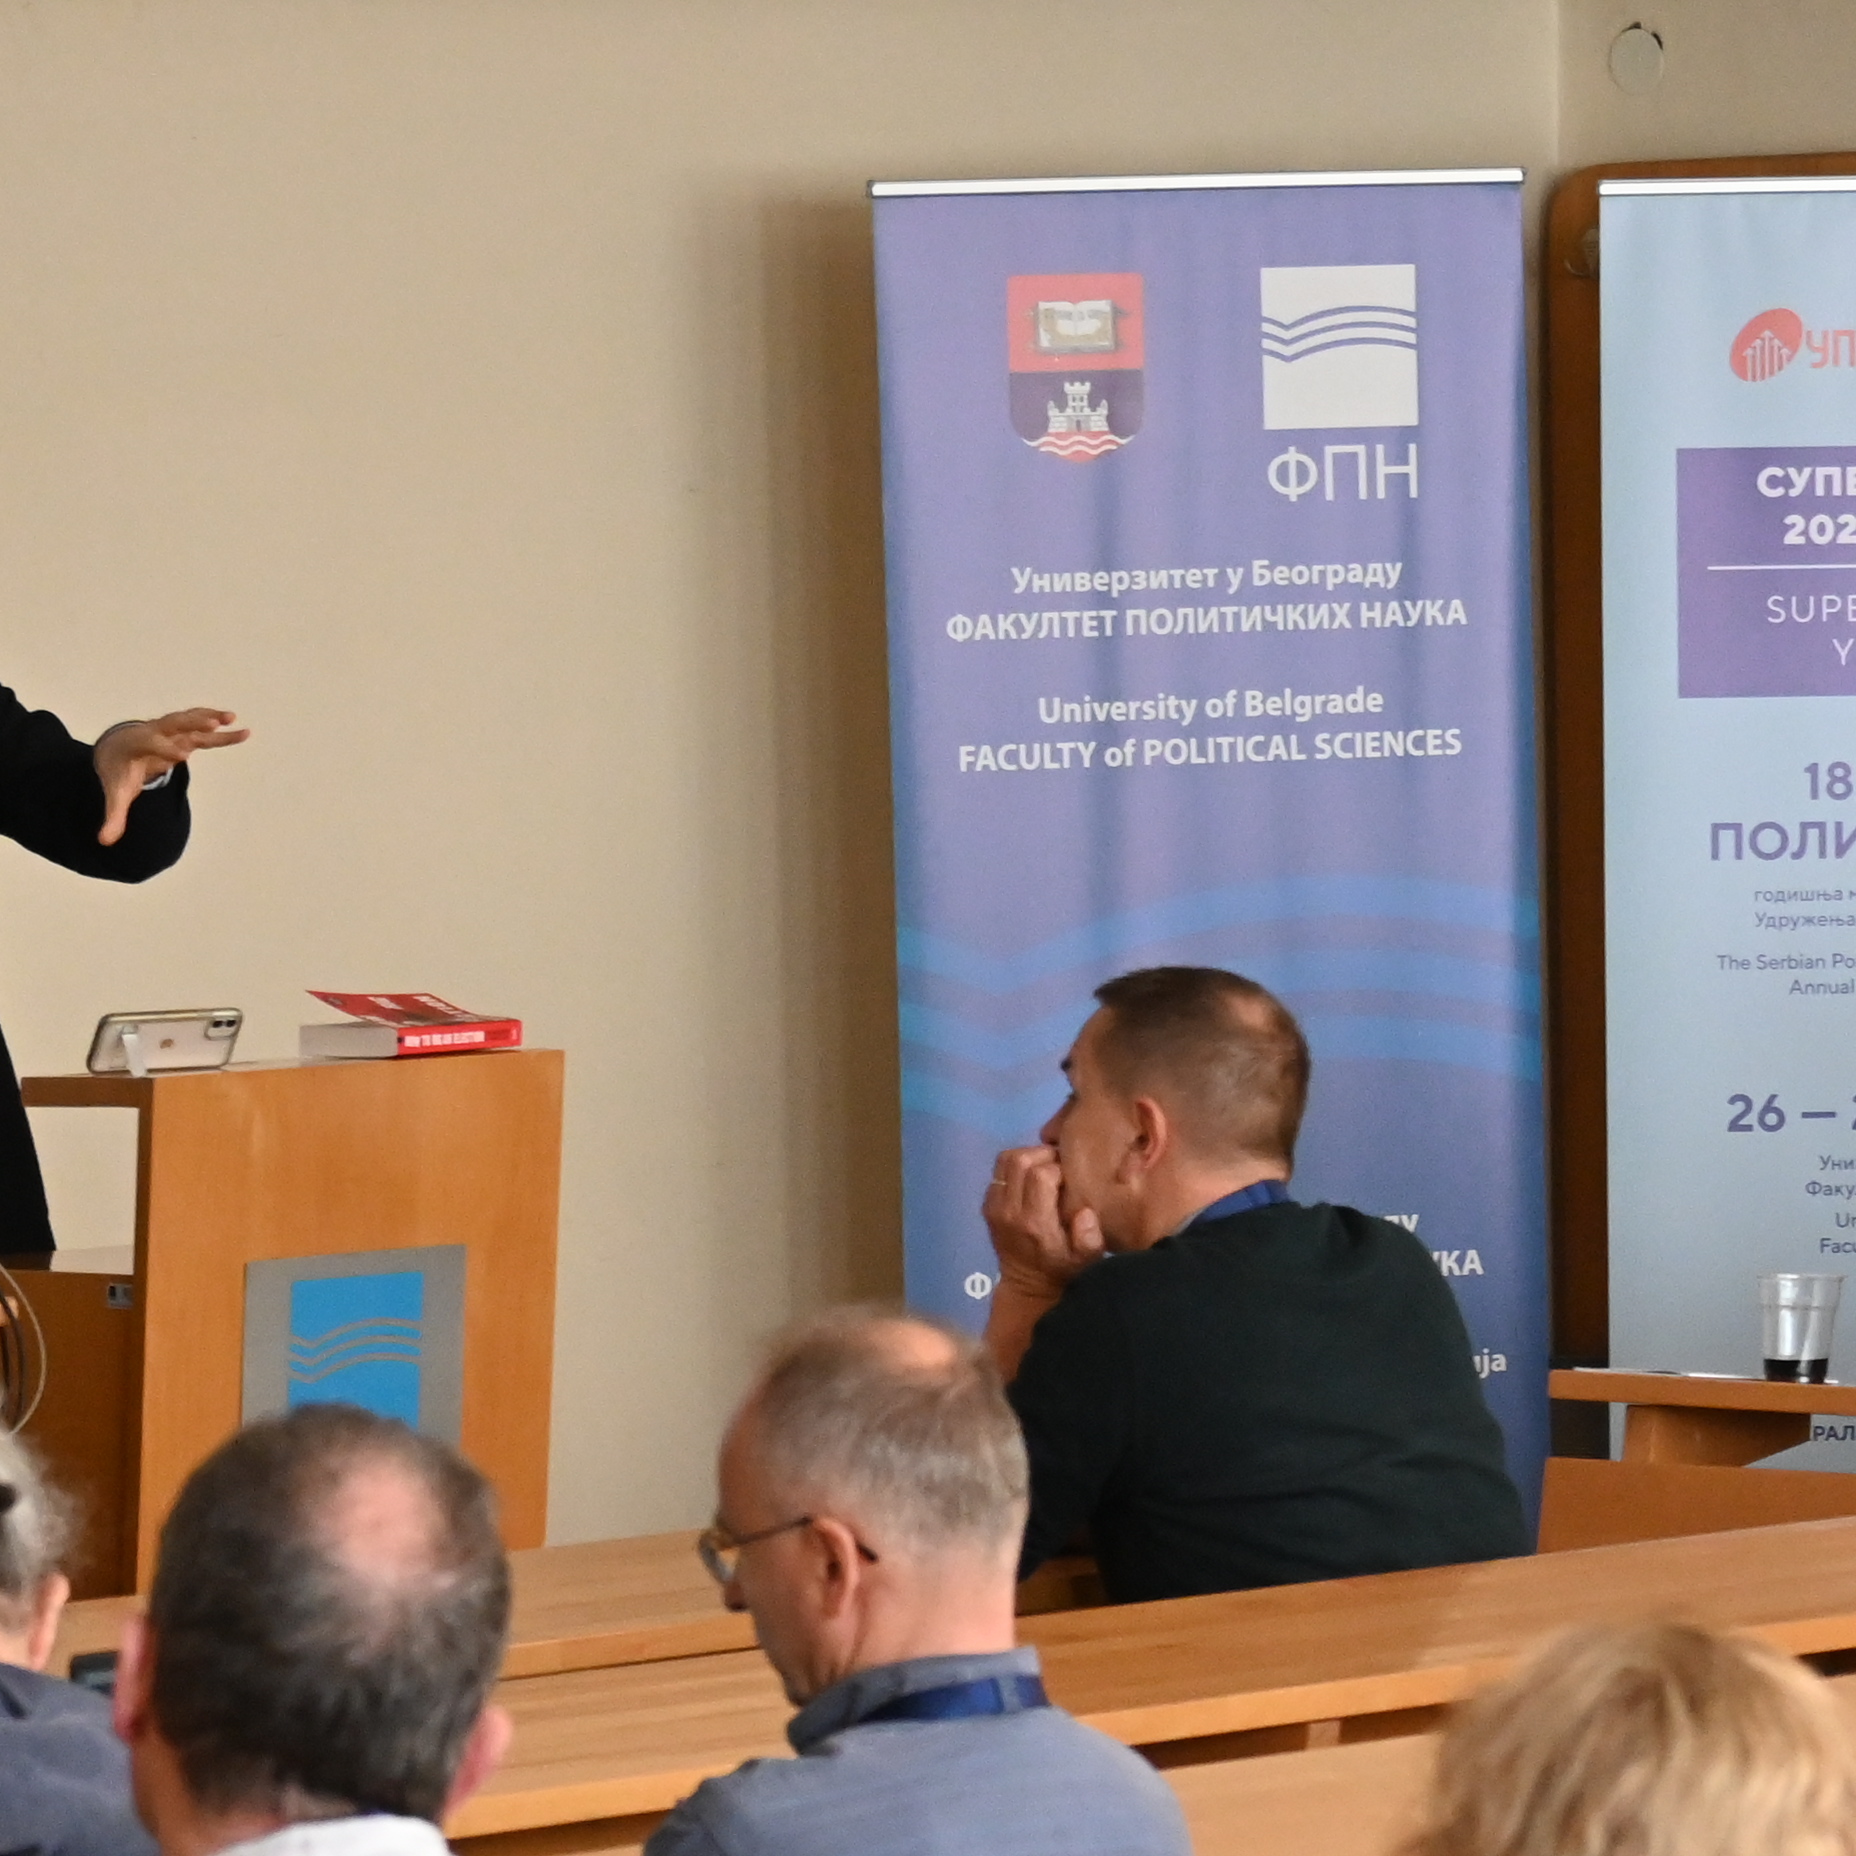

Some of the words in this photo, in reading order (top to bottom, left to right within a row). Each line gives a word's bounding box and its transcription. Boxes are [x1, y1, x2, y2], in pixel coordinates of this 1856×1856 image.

[1266, 443, 1420, 503] ФПН
[1010, 563, 1219, 596] Универзитет
[1225, 567, 1245, 596] у
[1251, 558, 1403, 592] Београду
[945, 609, 1115, 643] ФАКУЛТЕТ
[1125, 603, 1351, 637] ПОЛИТИЧКИХ
[1360, 599, 1468, 629] НАУКА
[1037, 692, 1197, 728] University
[1205, 690, 1235, 721] of
[1244, 685, 1384, 722] Belgrade
[958, 741, 1097, 773] FACULTY
[1104, 741, 1136, 769] of
[1143, 733, 1307, 766] POLITICAL
[1314, 728, 1463, 760] SCIENCES
[1717, 954, 1751, 970] The
[1756, 953, 1826, 970] Serbian
[1789, 978, 1855, 995] Annual
[1726, 1093, 1785, 1133] 26
